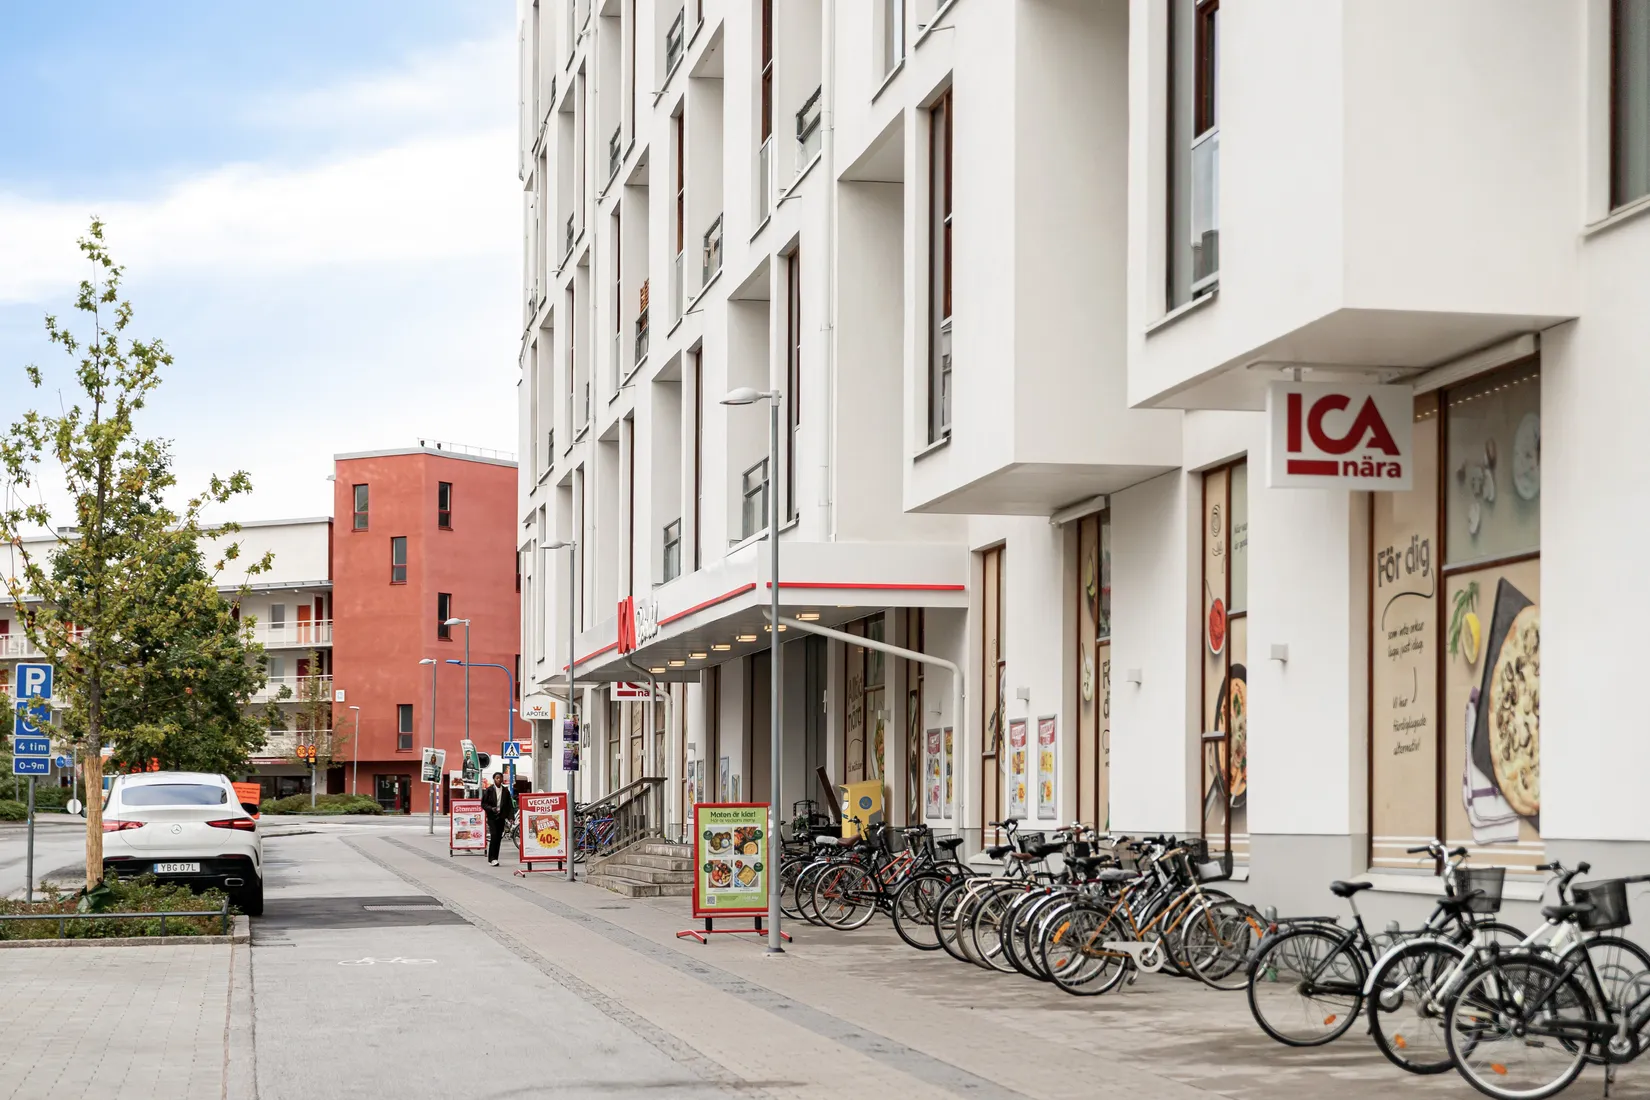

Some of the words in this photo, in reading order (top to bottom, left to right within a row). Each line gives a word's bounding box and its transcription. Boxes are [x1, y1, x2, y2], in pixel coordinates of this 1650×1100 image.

[1287, 393, 1401, 456] ICA
[1342, 456, 1402, 478] nära
[1377, 545, 1401, 588] För
[1405, 534, 1430, 578] dig
[25, 668, 46, 695] P
[18, 742, 26, 751] 4
[30, 742, 47, 751] tim
[381, 780, 390, 789] 15
[529, 797, 559, 806] VECKANS
[539, 833, 559, 844] 40:-
[161, 863, 178, 871] YBG
[180, 863, 197, 871] 07L
